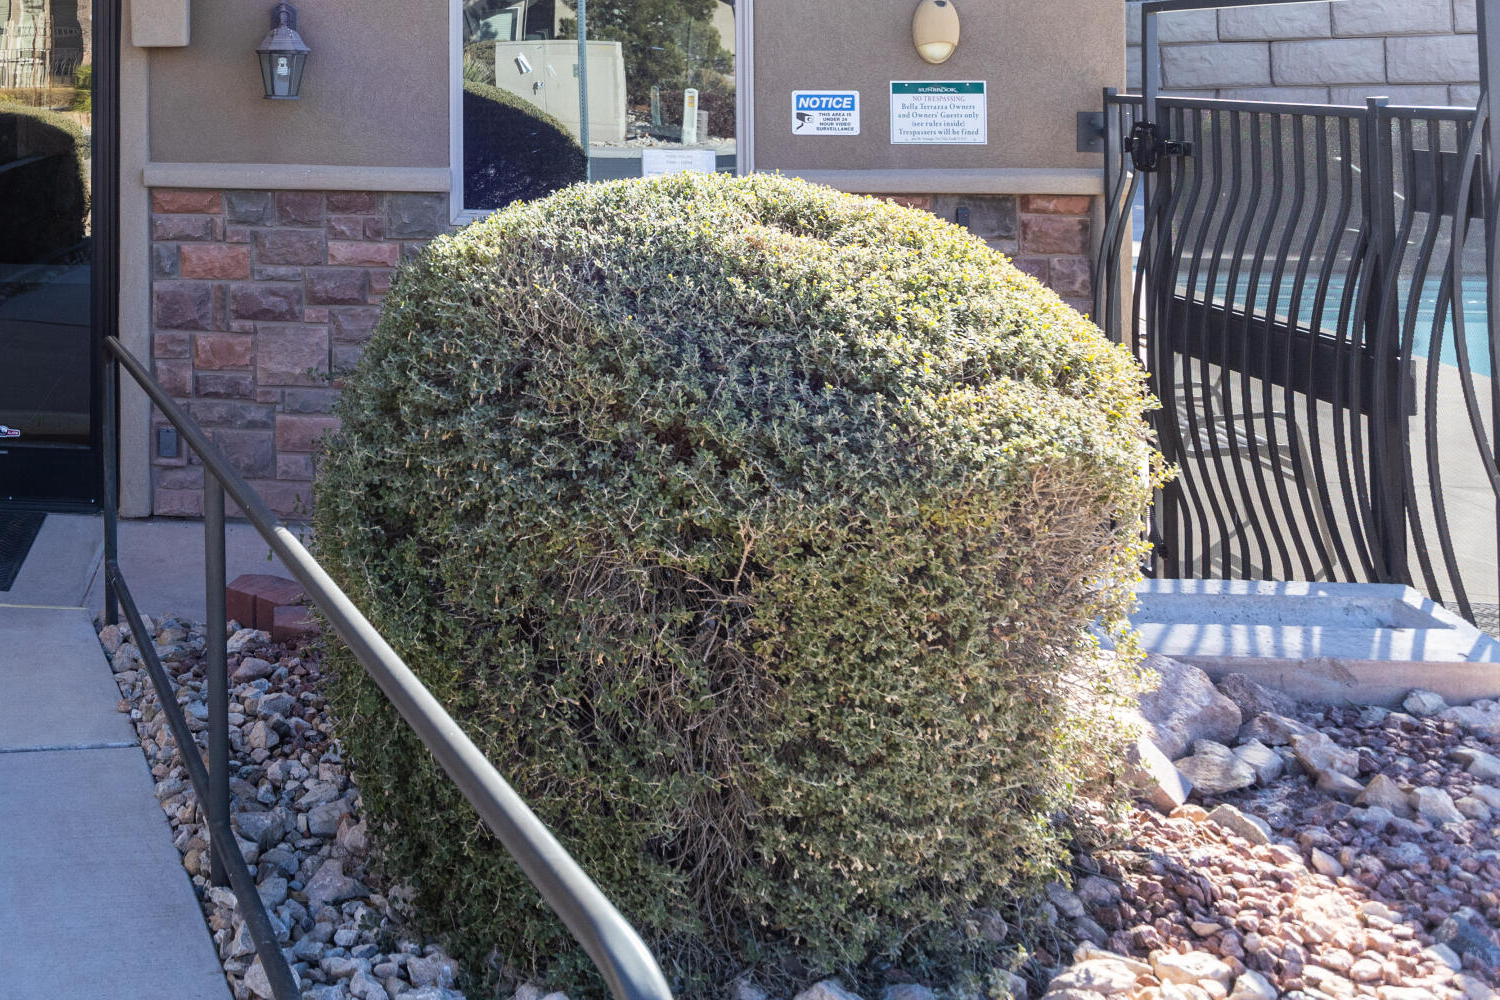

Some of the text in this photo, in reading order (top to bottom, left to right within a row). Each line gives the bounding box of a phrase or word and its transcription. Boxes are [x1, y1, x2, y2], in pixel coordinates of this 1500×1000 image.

[798, 97, 853, 109] NOTICE
[940, 111, 963, 119] Guests
[964, 111, 980, 120] only
[899, 128, 937, 136] Trespassers
